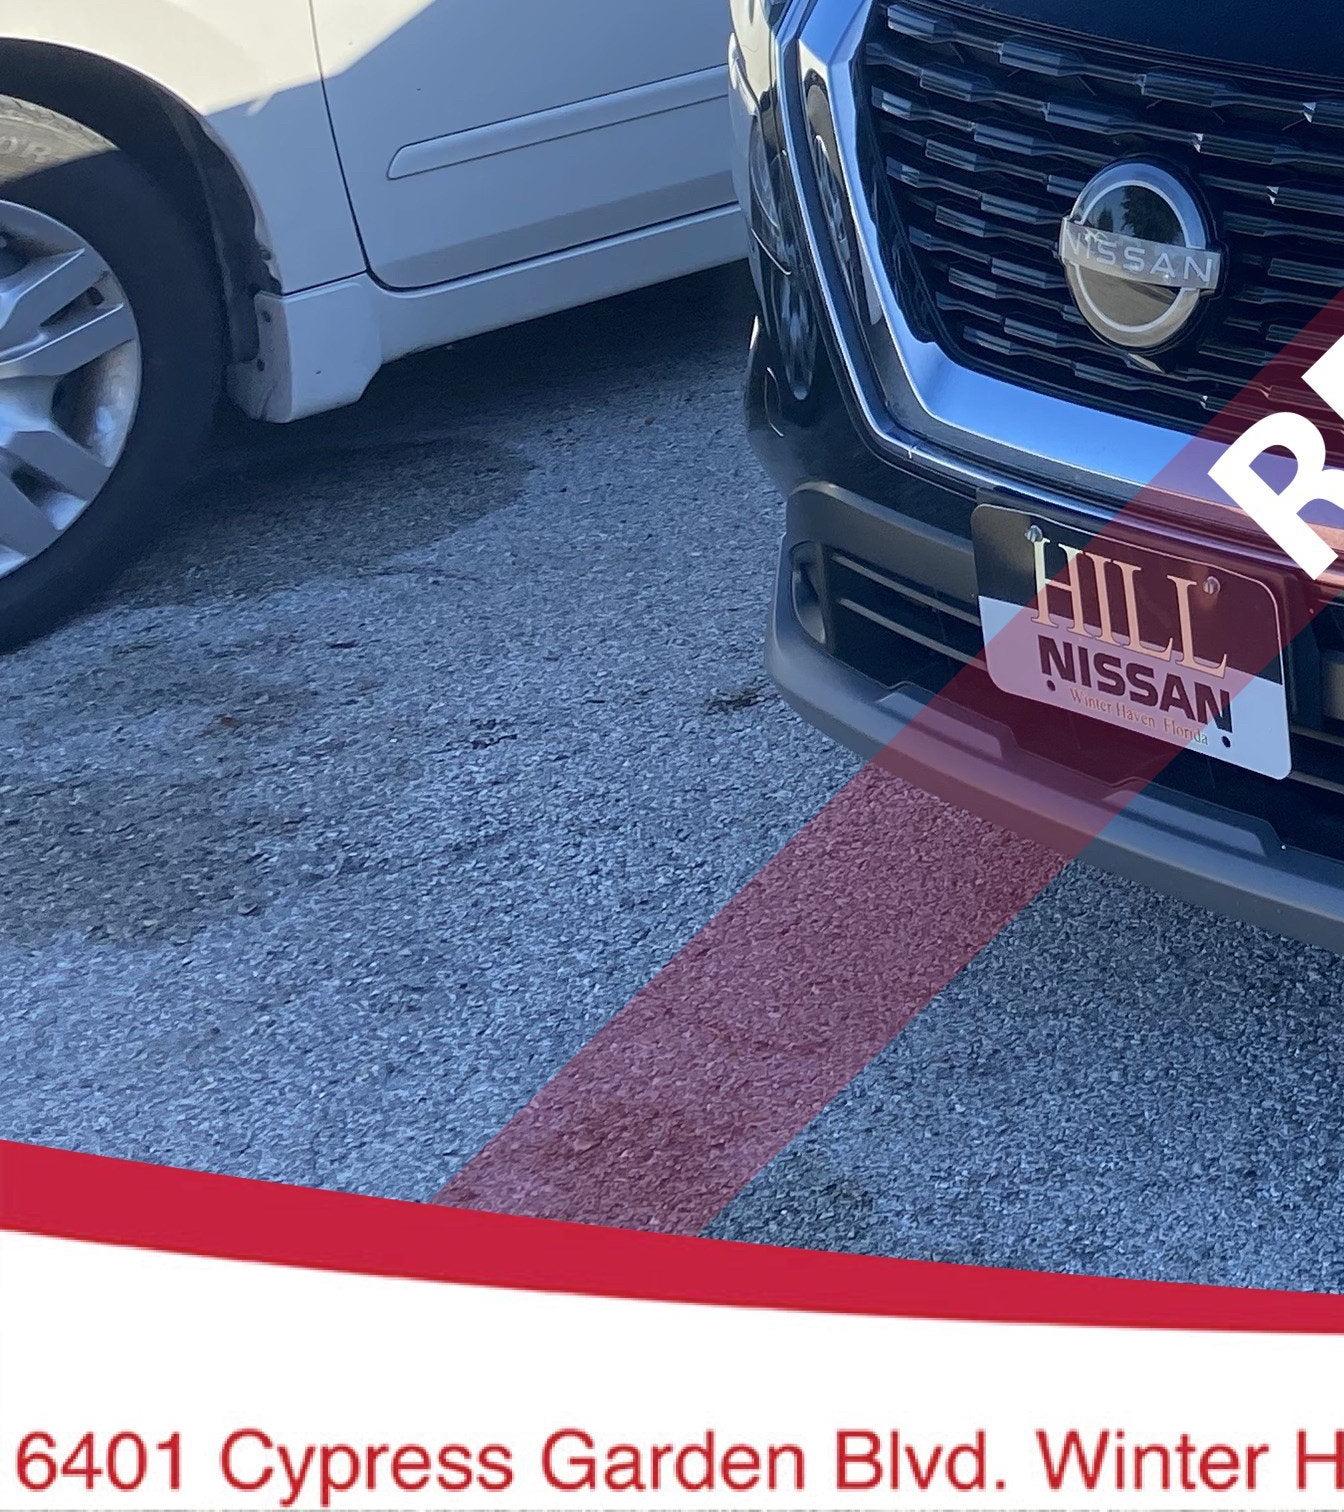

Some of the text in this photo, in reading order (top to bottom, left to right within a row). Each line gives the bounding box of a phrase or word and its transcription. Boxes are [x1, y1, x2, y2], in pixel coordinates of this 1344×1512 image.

[1064, 223, 1213, 284] NISSAN
[1030, 536, 1228, 679] HILL
[1037, 634, 1233, 734] NISSAN
[1070, 688, 1209, 746] Winter Haven Florida
